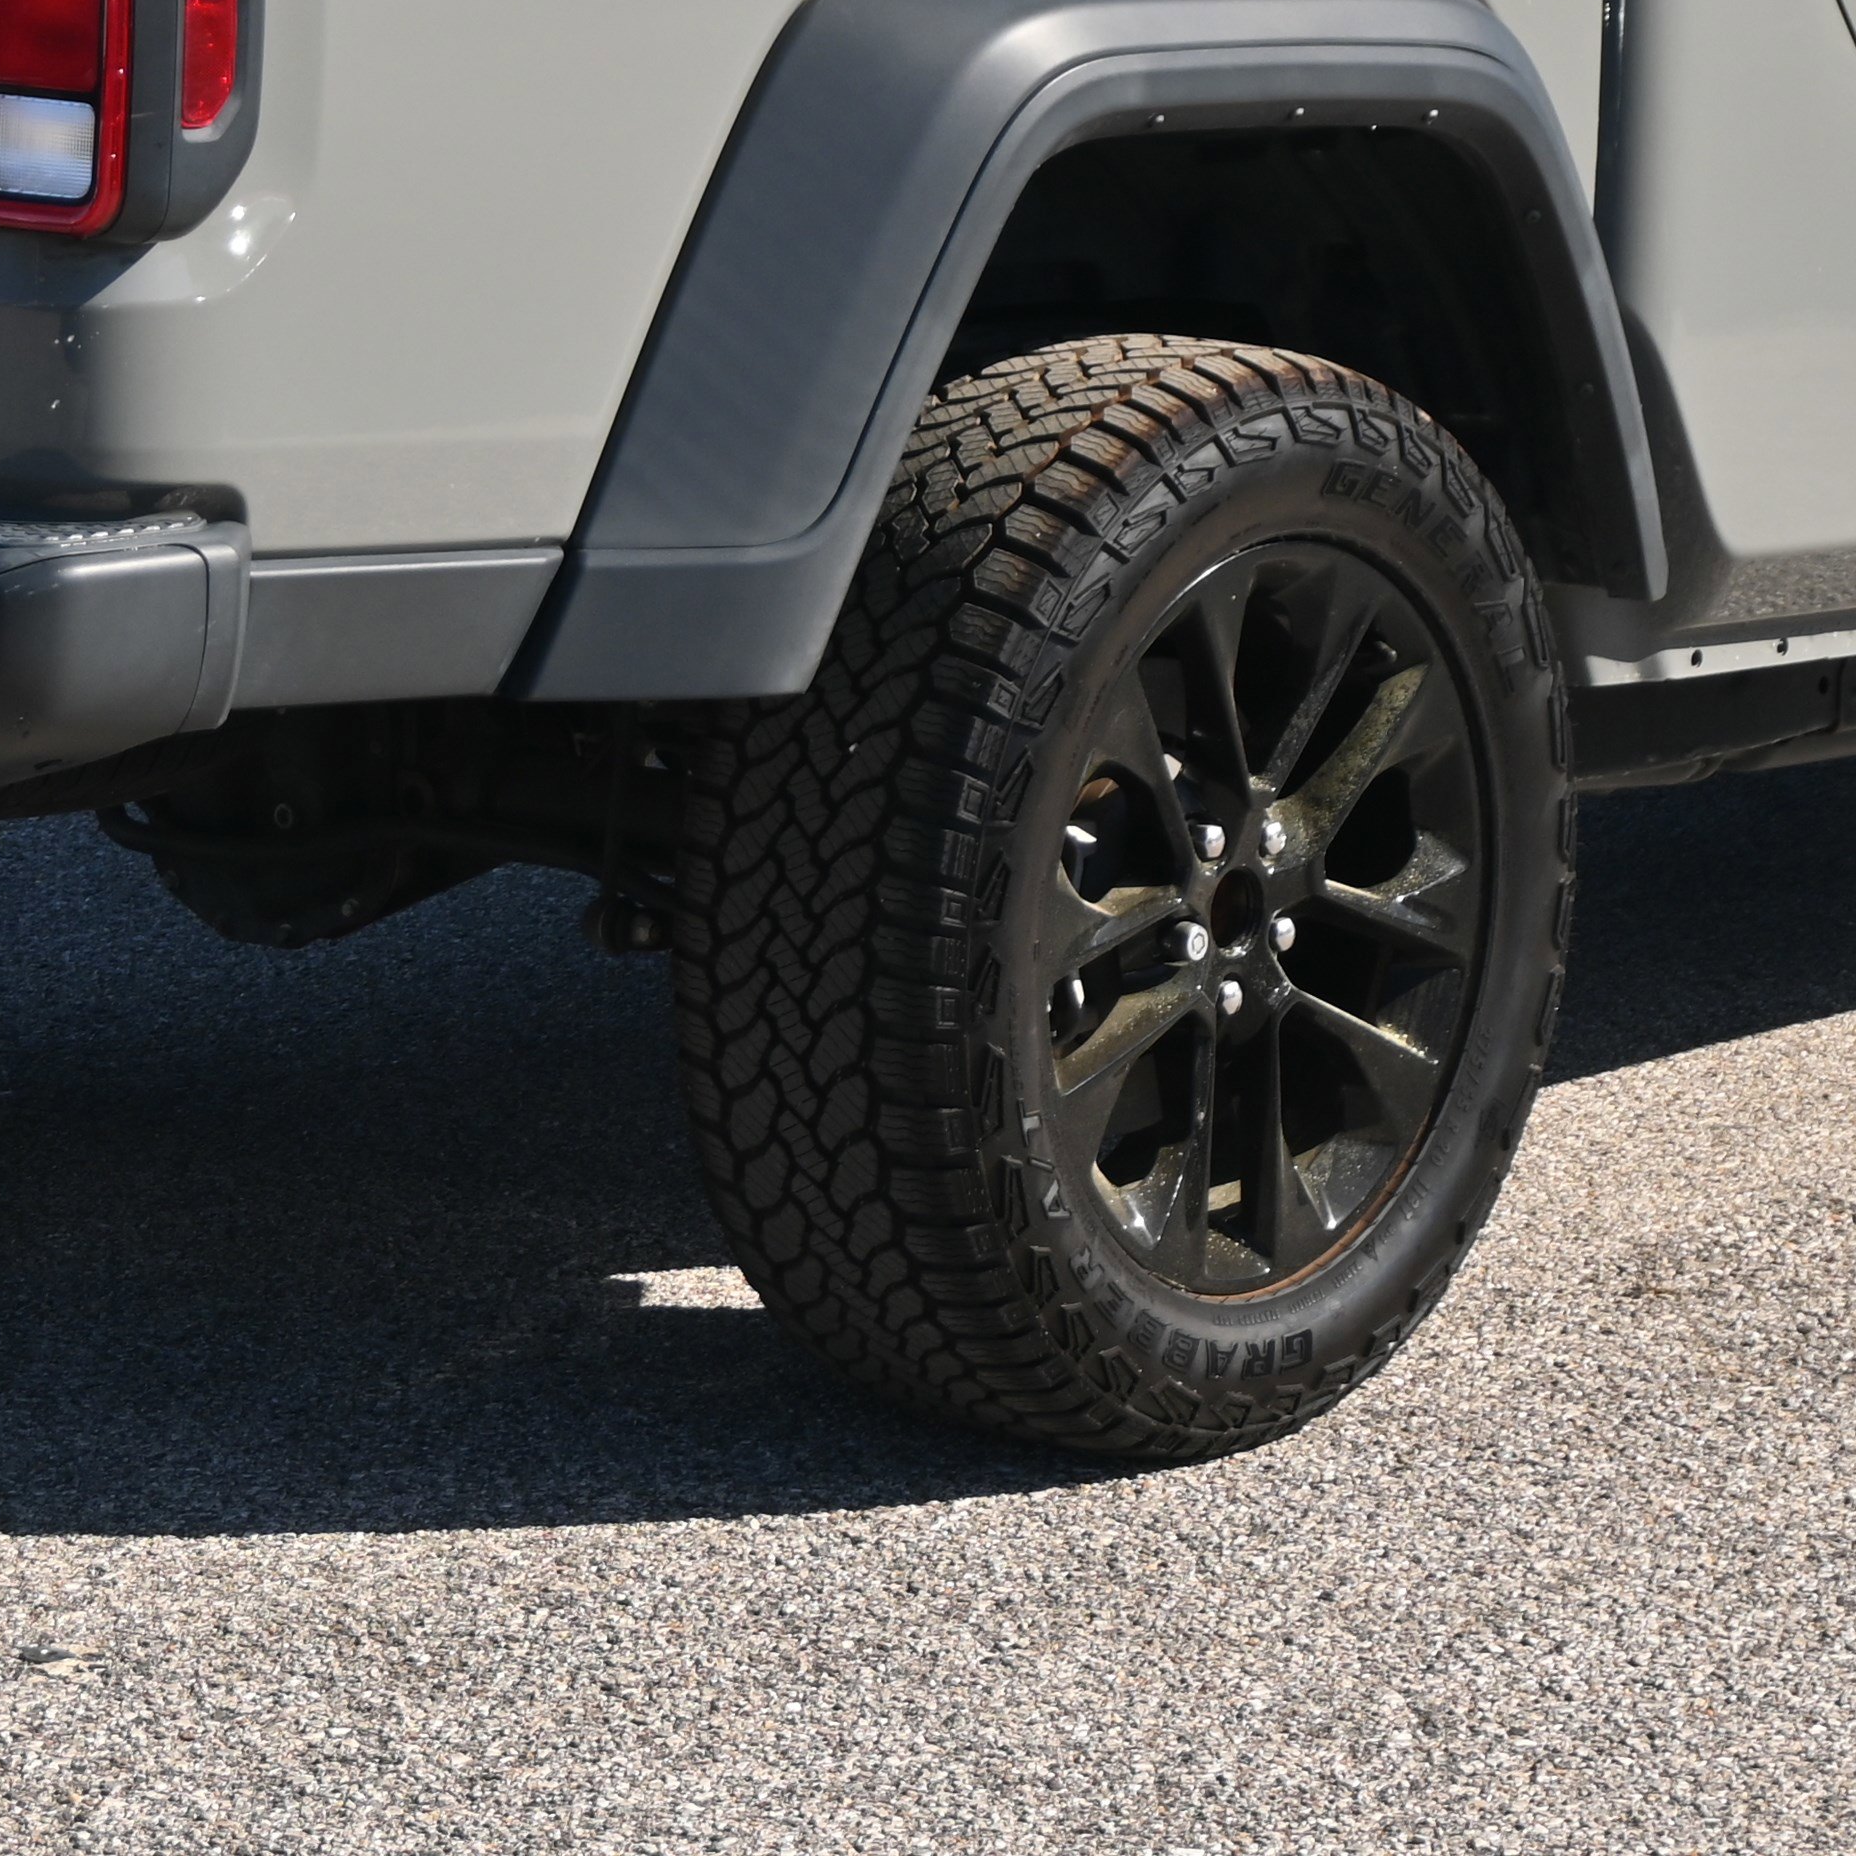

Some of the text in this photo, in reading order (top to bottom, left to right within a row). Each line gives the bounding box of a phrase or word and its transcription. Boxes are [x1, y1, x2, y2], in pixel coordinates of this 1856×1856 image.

[1320, 457, 1527, 695] GENERAL
[1016, 1096, 1073, 1220] A/T
[1068, 1245, 1314, 1379] GRABBER
